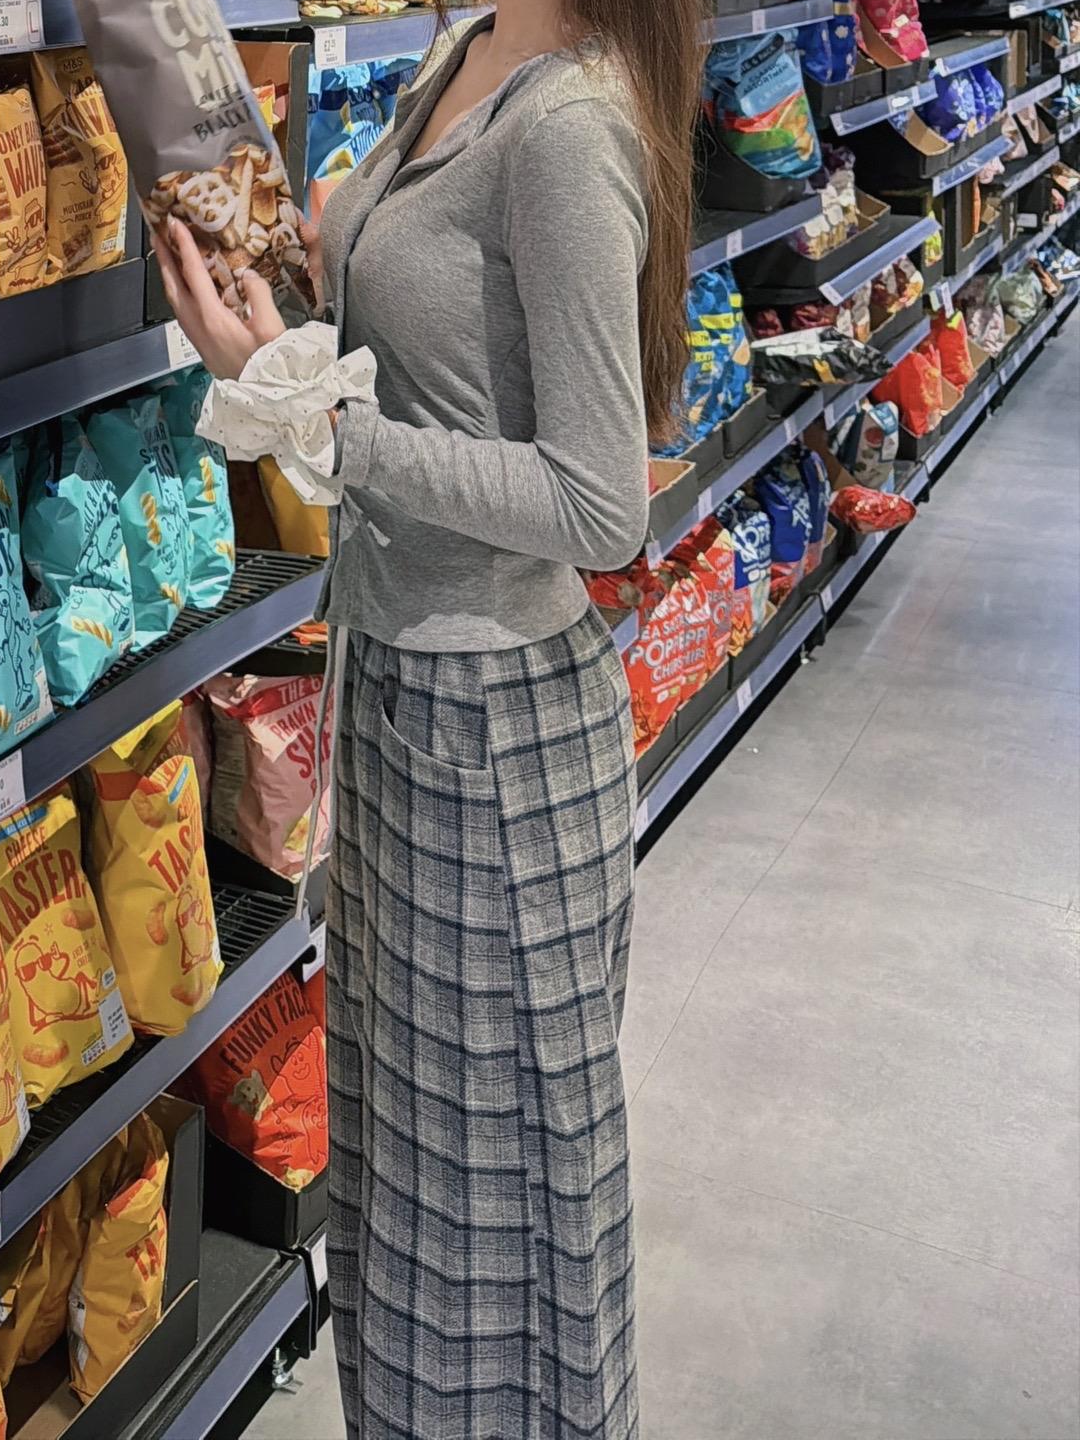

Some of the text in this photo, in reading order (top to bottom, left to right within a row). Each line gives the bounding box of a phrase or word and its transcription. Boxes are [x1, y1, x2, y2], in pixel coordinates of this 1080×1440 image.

[4, 143, 47, 200] WAVE
[278, 678, 306, 705] THE
[269, 700, 317, 742] PRAWN
[4, 825, 49, 871] CHEESE
[220, 1003, 279, 1075] FUNKY
